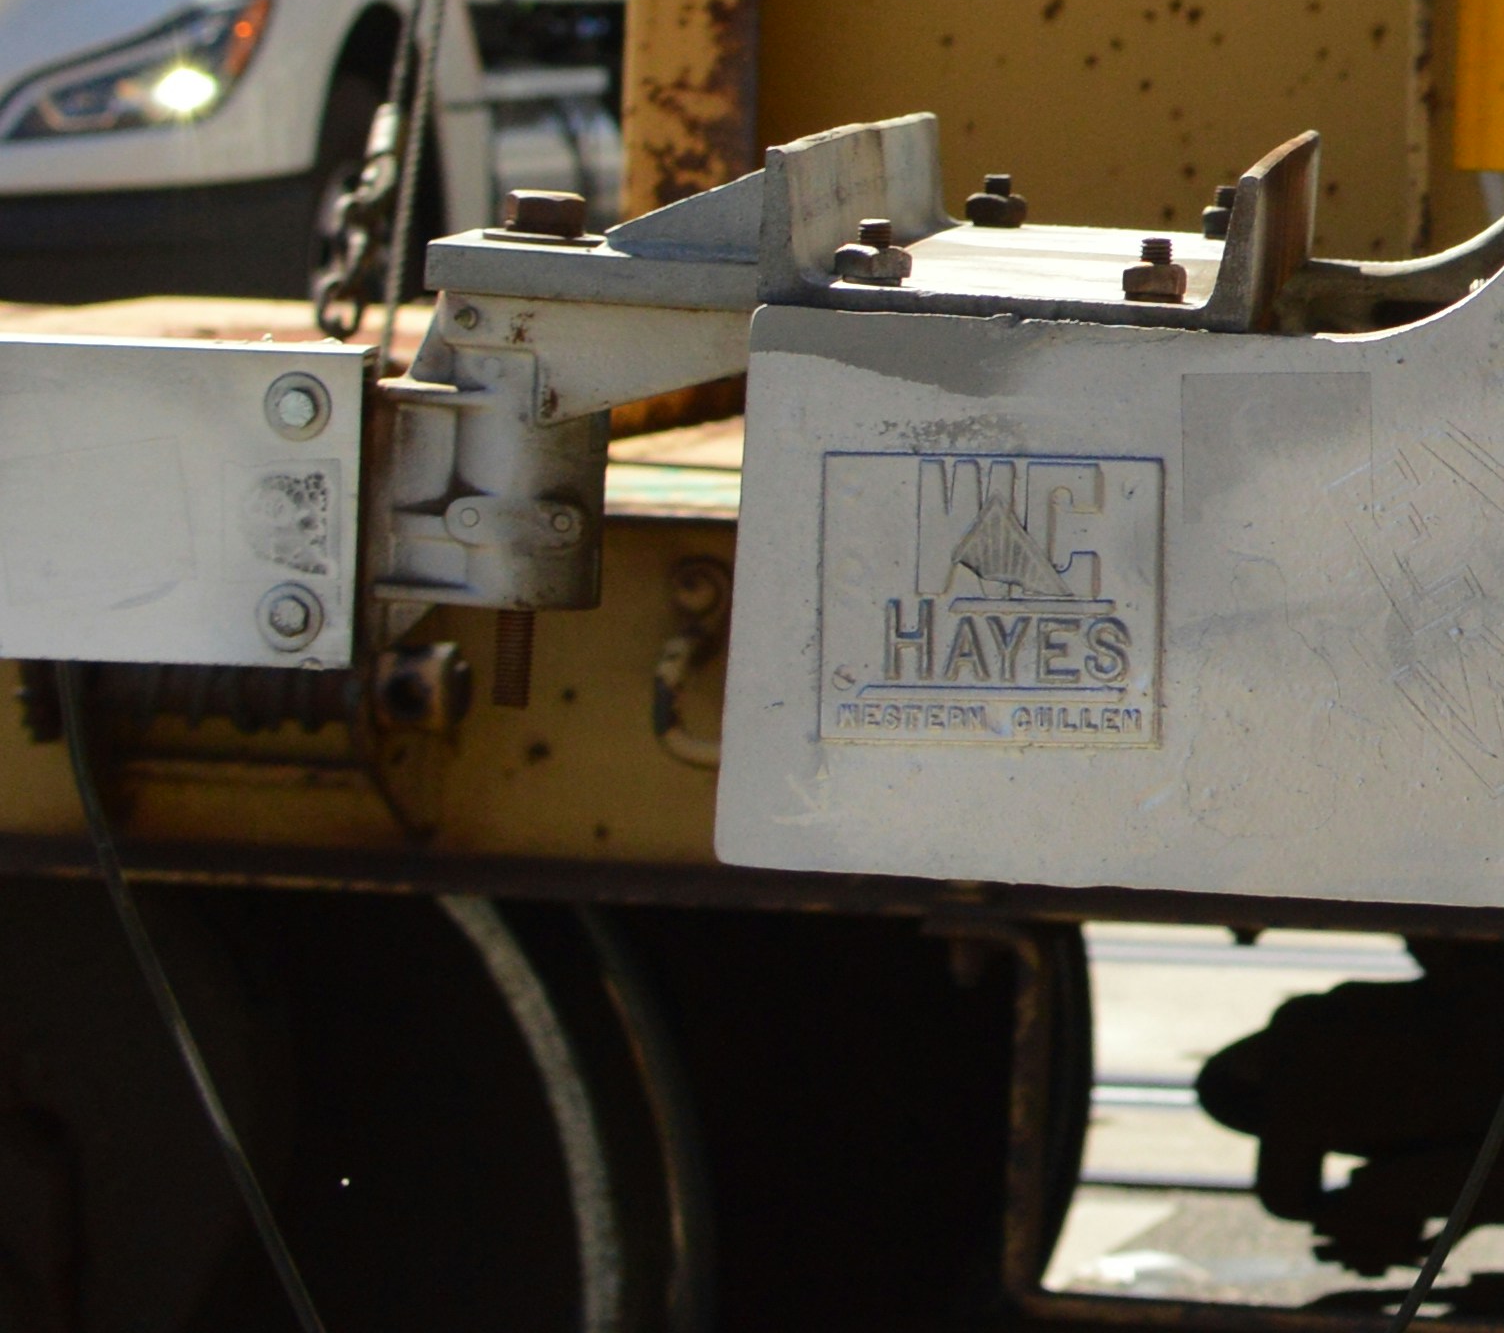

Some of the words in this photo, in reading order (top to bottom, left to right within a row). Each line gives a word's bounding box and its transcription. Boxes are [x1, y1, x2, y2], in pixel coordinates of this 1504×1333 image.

[883, 596, 1134, 685] HAYES
[836, 702, 990, 731] WESTERN
[1010, 704, 1144, 735] CULLEN
